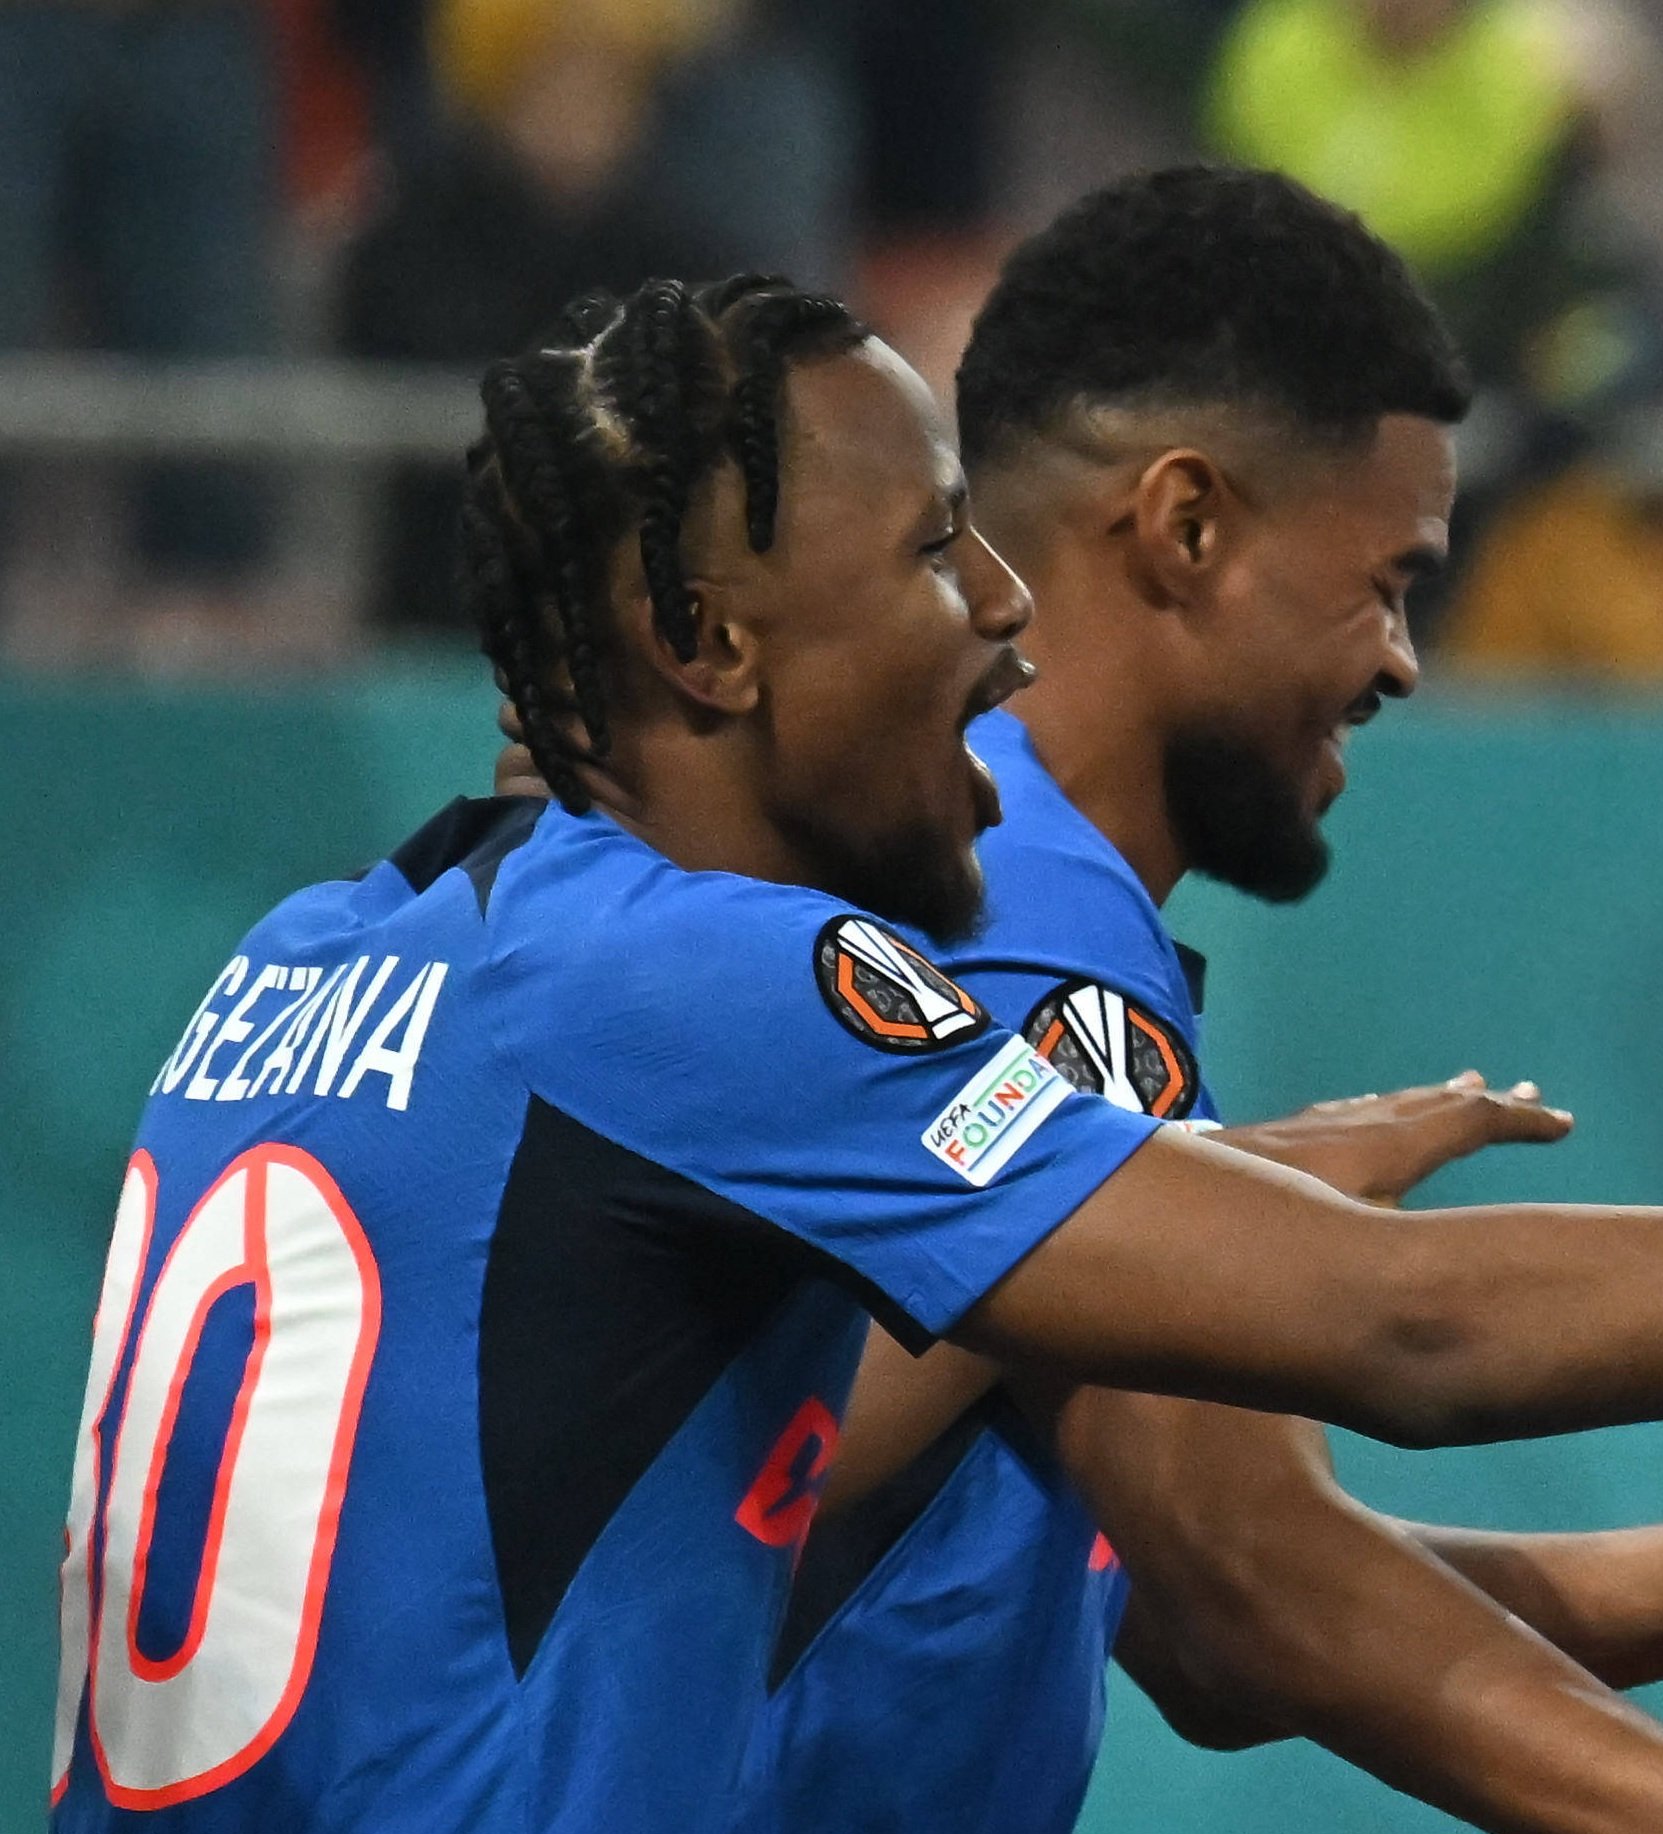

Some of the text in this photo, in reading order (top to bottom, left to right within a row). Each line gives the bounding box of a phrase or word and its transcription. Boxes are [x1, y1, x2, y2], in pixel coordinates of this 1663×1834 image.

[150, 954, 449, 1112] GEZANA
[930, 1103, 972, 1148] UEFA
[945, 1052, 1050, 1166] FOUNDA
